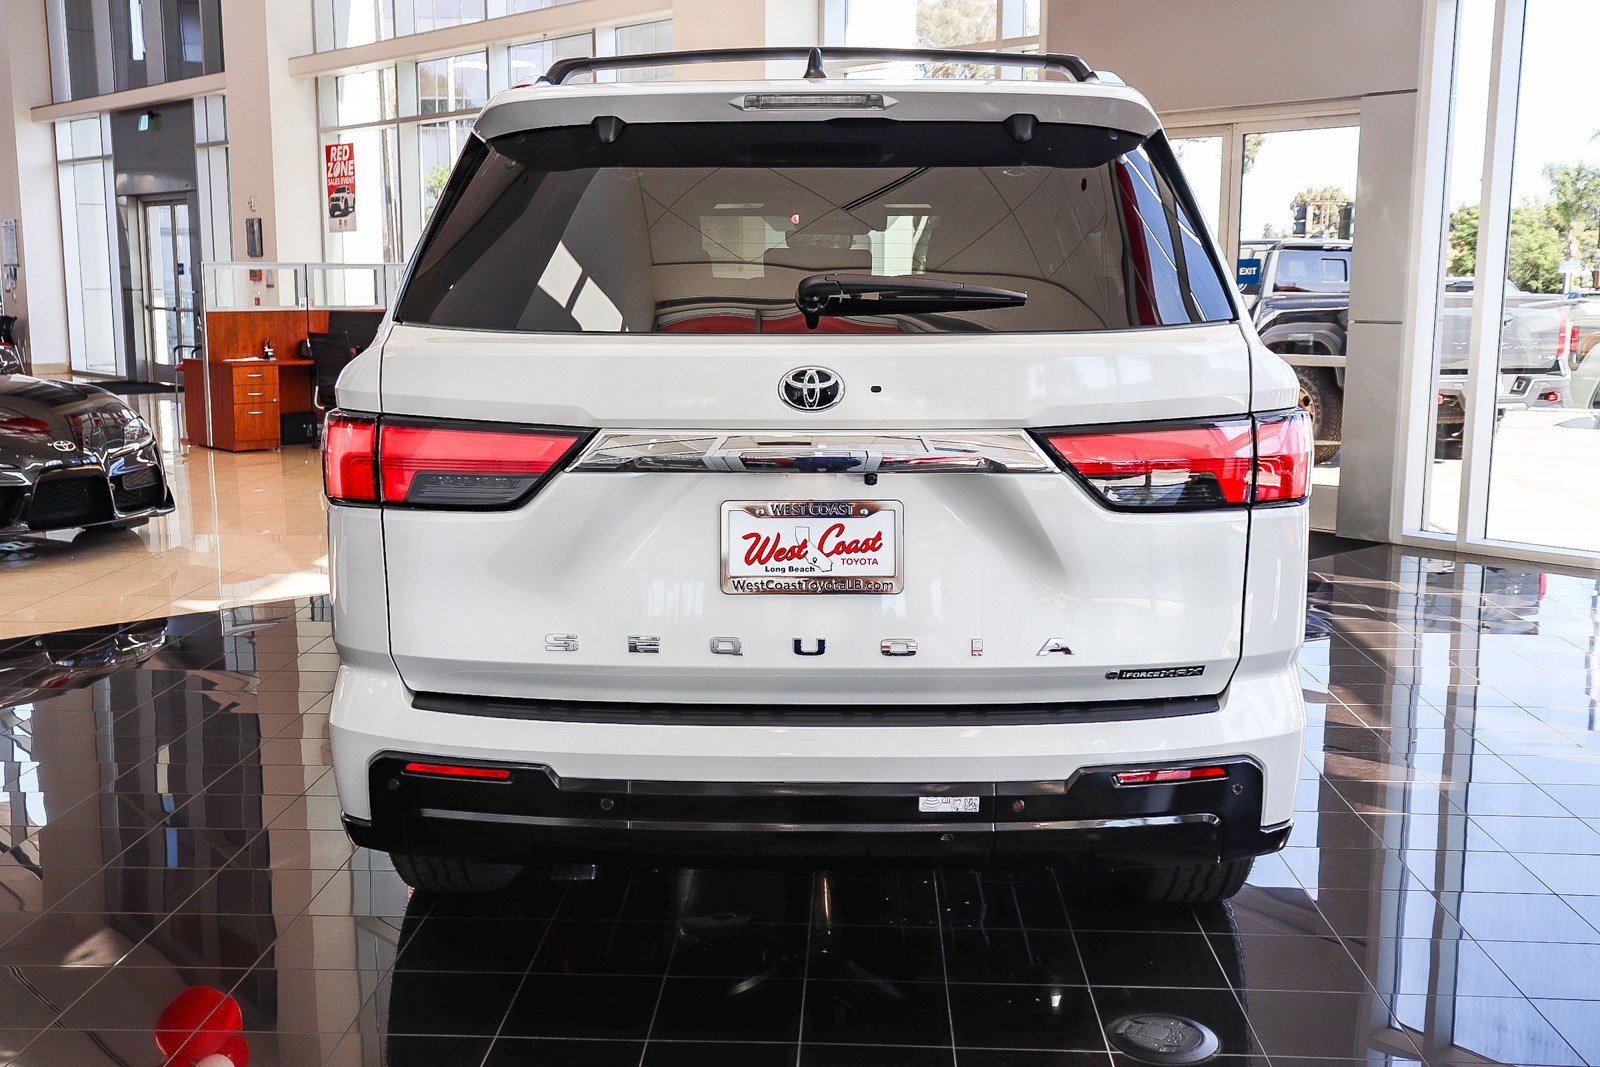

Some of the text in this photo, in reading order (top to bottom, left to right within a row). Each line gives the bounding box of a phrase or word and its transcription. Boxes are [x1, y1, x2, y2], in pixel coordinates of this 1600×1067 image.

[330, 145, 350, 161] RED
[327, 160, 354, 177] ZONE
[328, 177, 354, 186] SALES EVENT
[1239, 267, 1257, 275] EXIT
[770, 503, 855, 516] WEST COAST
[742, 523, 883, 565] West Coast
[841, 557, 879, 566] TOYOTA
[765, 565, 786, 573] Long
[732, 578, 894, 593] WestCoastToyotaLB.com
[544, 631, 1076, 657] SEQUOIA
